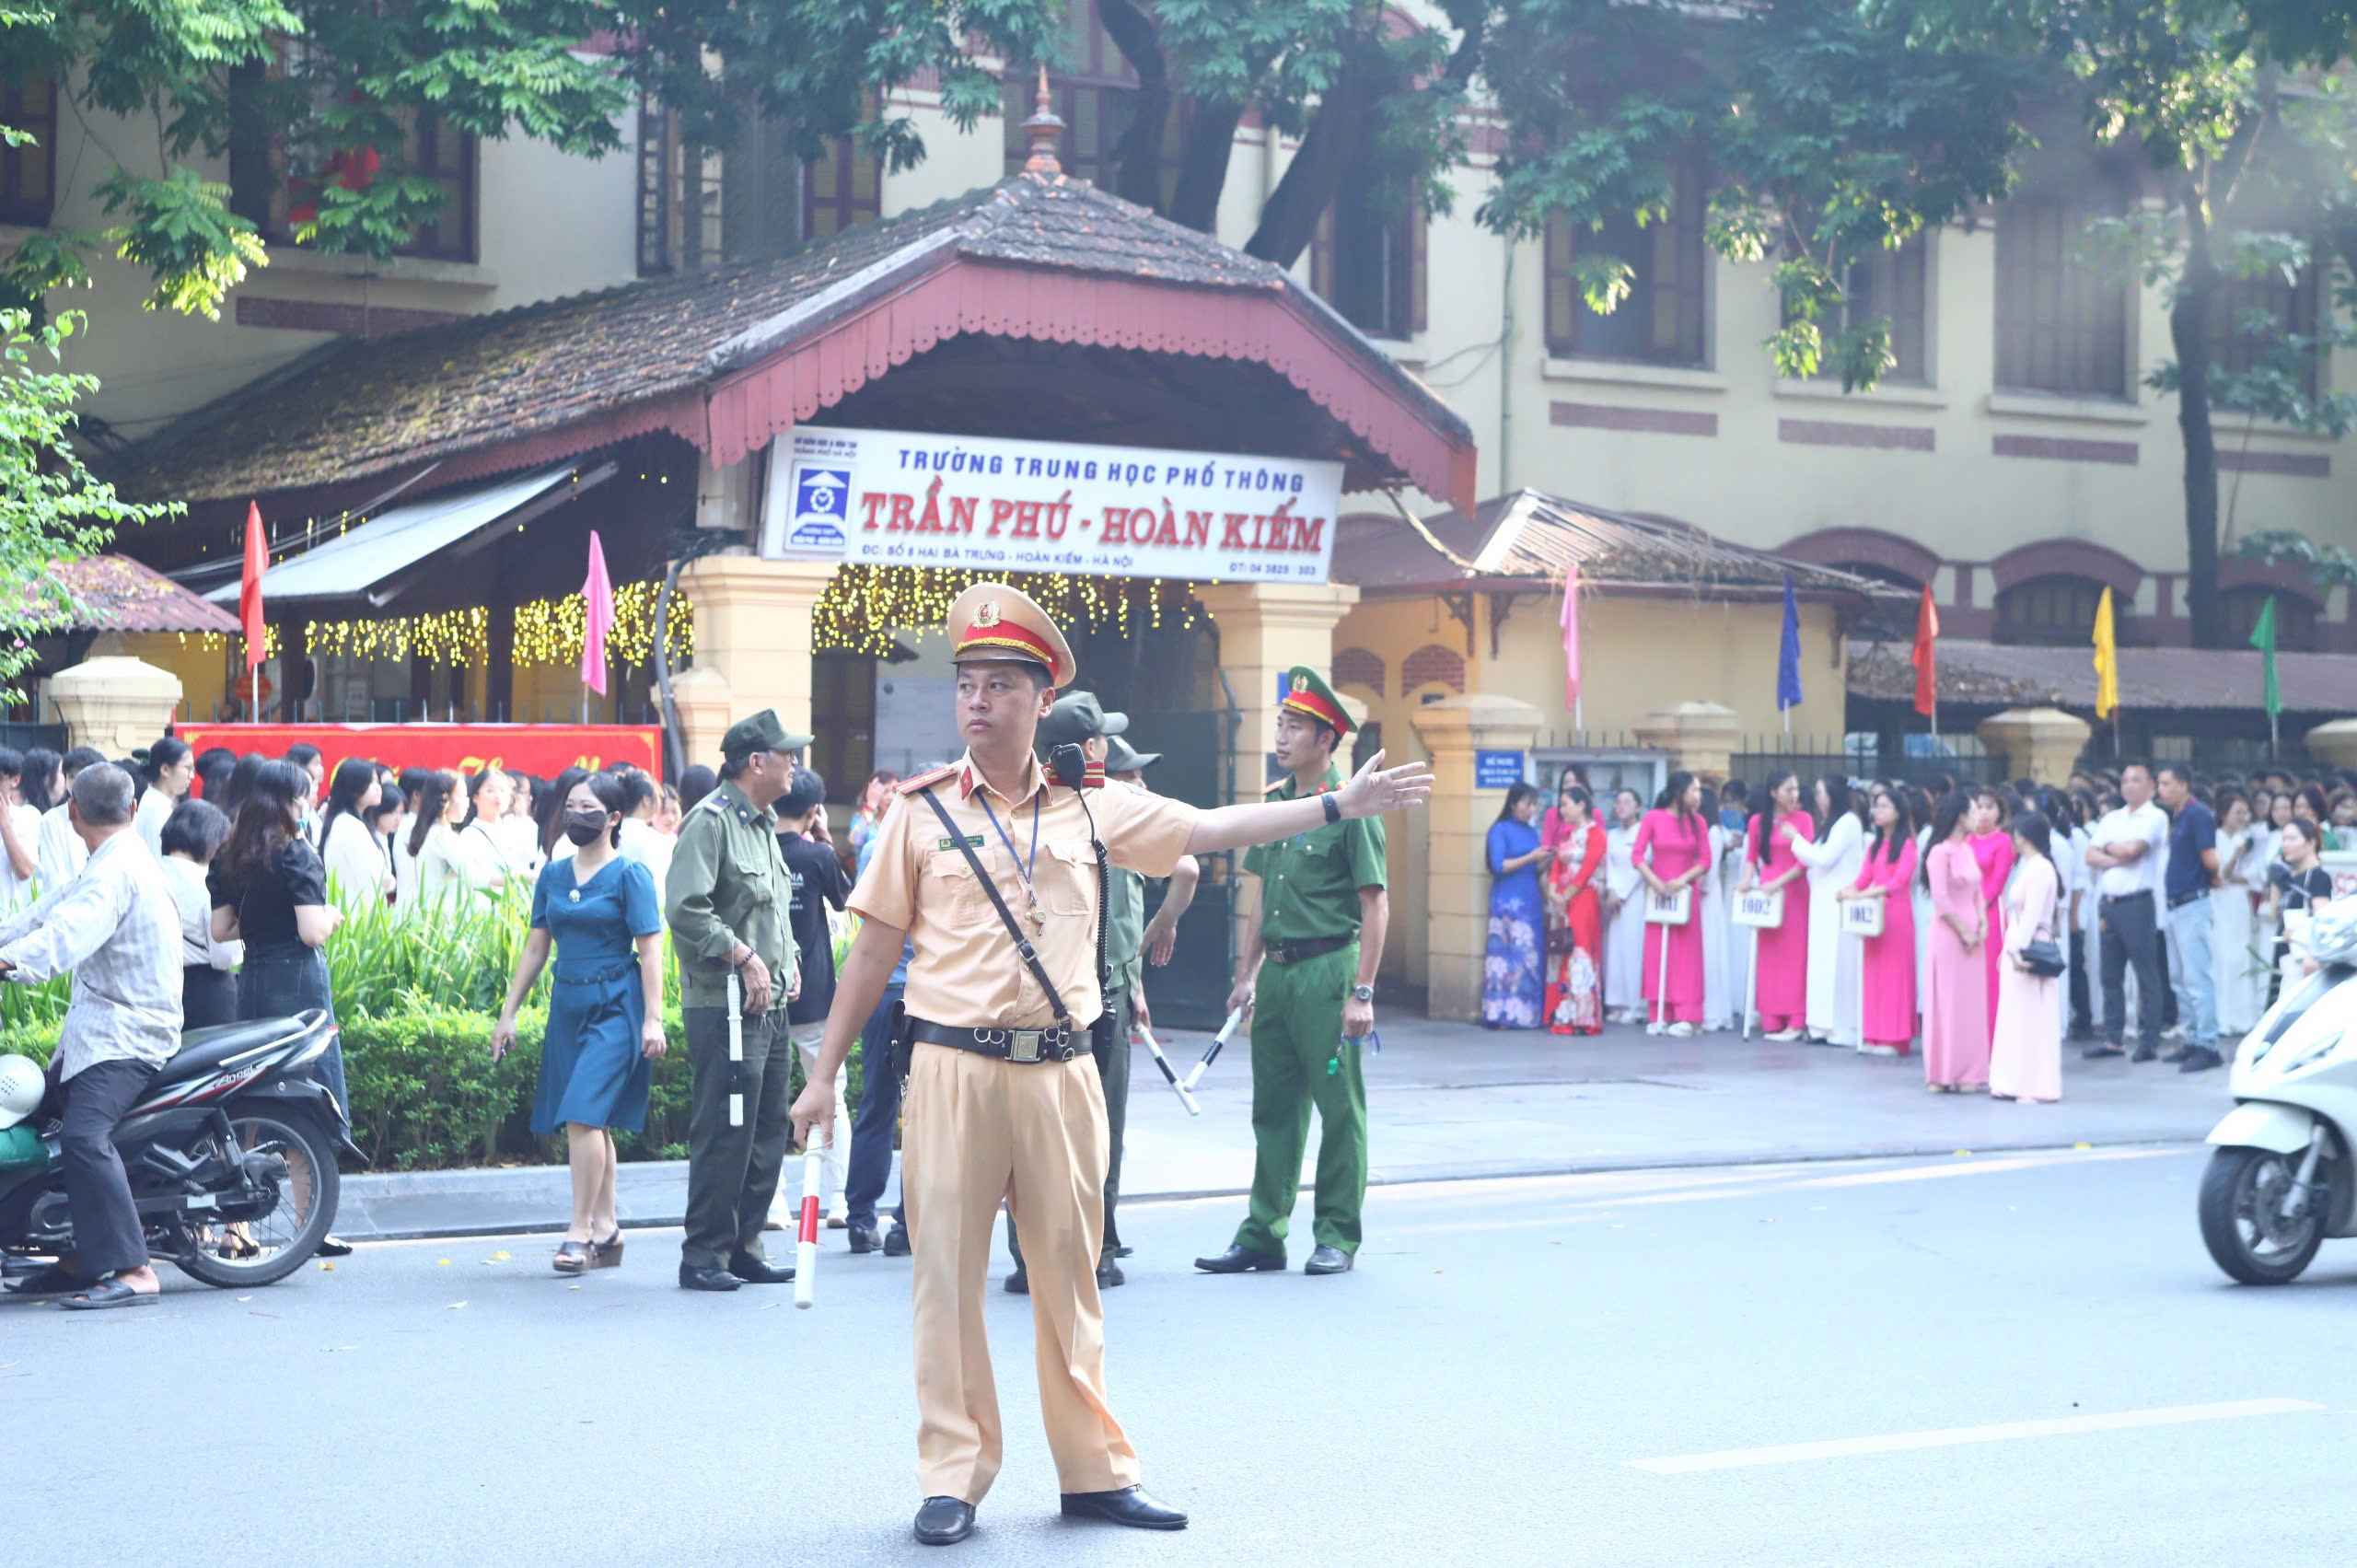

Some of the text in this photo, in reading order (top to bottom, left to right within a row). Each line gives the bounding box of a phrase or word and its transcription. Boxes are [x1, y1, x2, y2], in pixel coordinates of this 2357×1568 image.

[899, 447, 1004, 475] TRƯỜNG
[1015, 457, 1097, 481] TRUNG
[1108, 462, 1156, 487] HỌC
[1225, 468, 1305, 494] THÔNG
[861, 474, 981, 533] TRẦN
[986, 489, 1074, 540] PHÚ
[1098, 495, 1214, 548] HOÀN
[1218, 494, 1327, 552] KIẾM
[887, 541, 904, 556] SỐ
[918, 547, 938, 558] HAI
[944, 545, 959, 559] BÀ
[1016, 551, 1050, 563] HOÀN
[1053, 551, 1083, 564] KIẾM
[1093, 552, 1109, 566] HÀ
[1113, 554, 1133, 568] NỘI
[1742, 898, 1771, 915] 10D2
